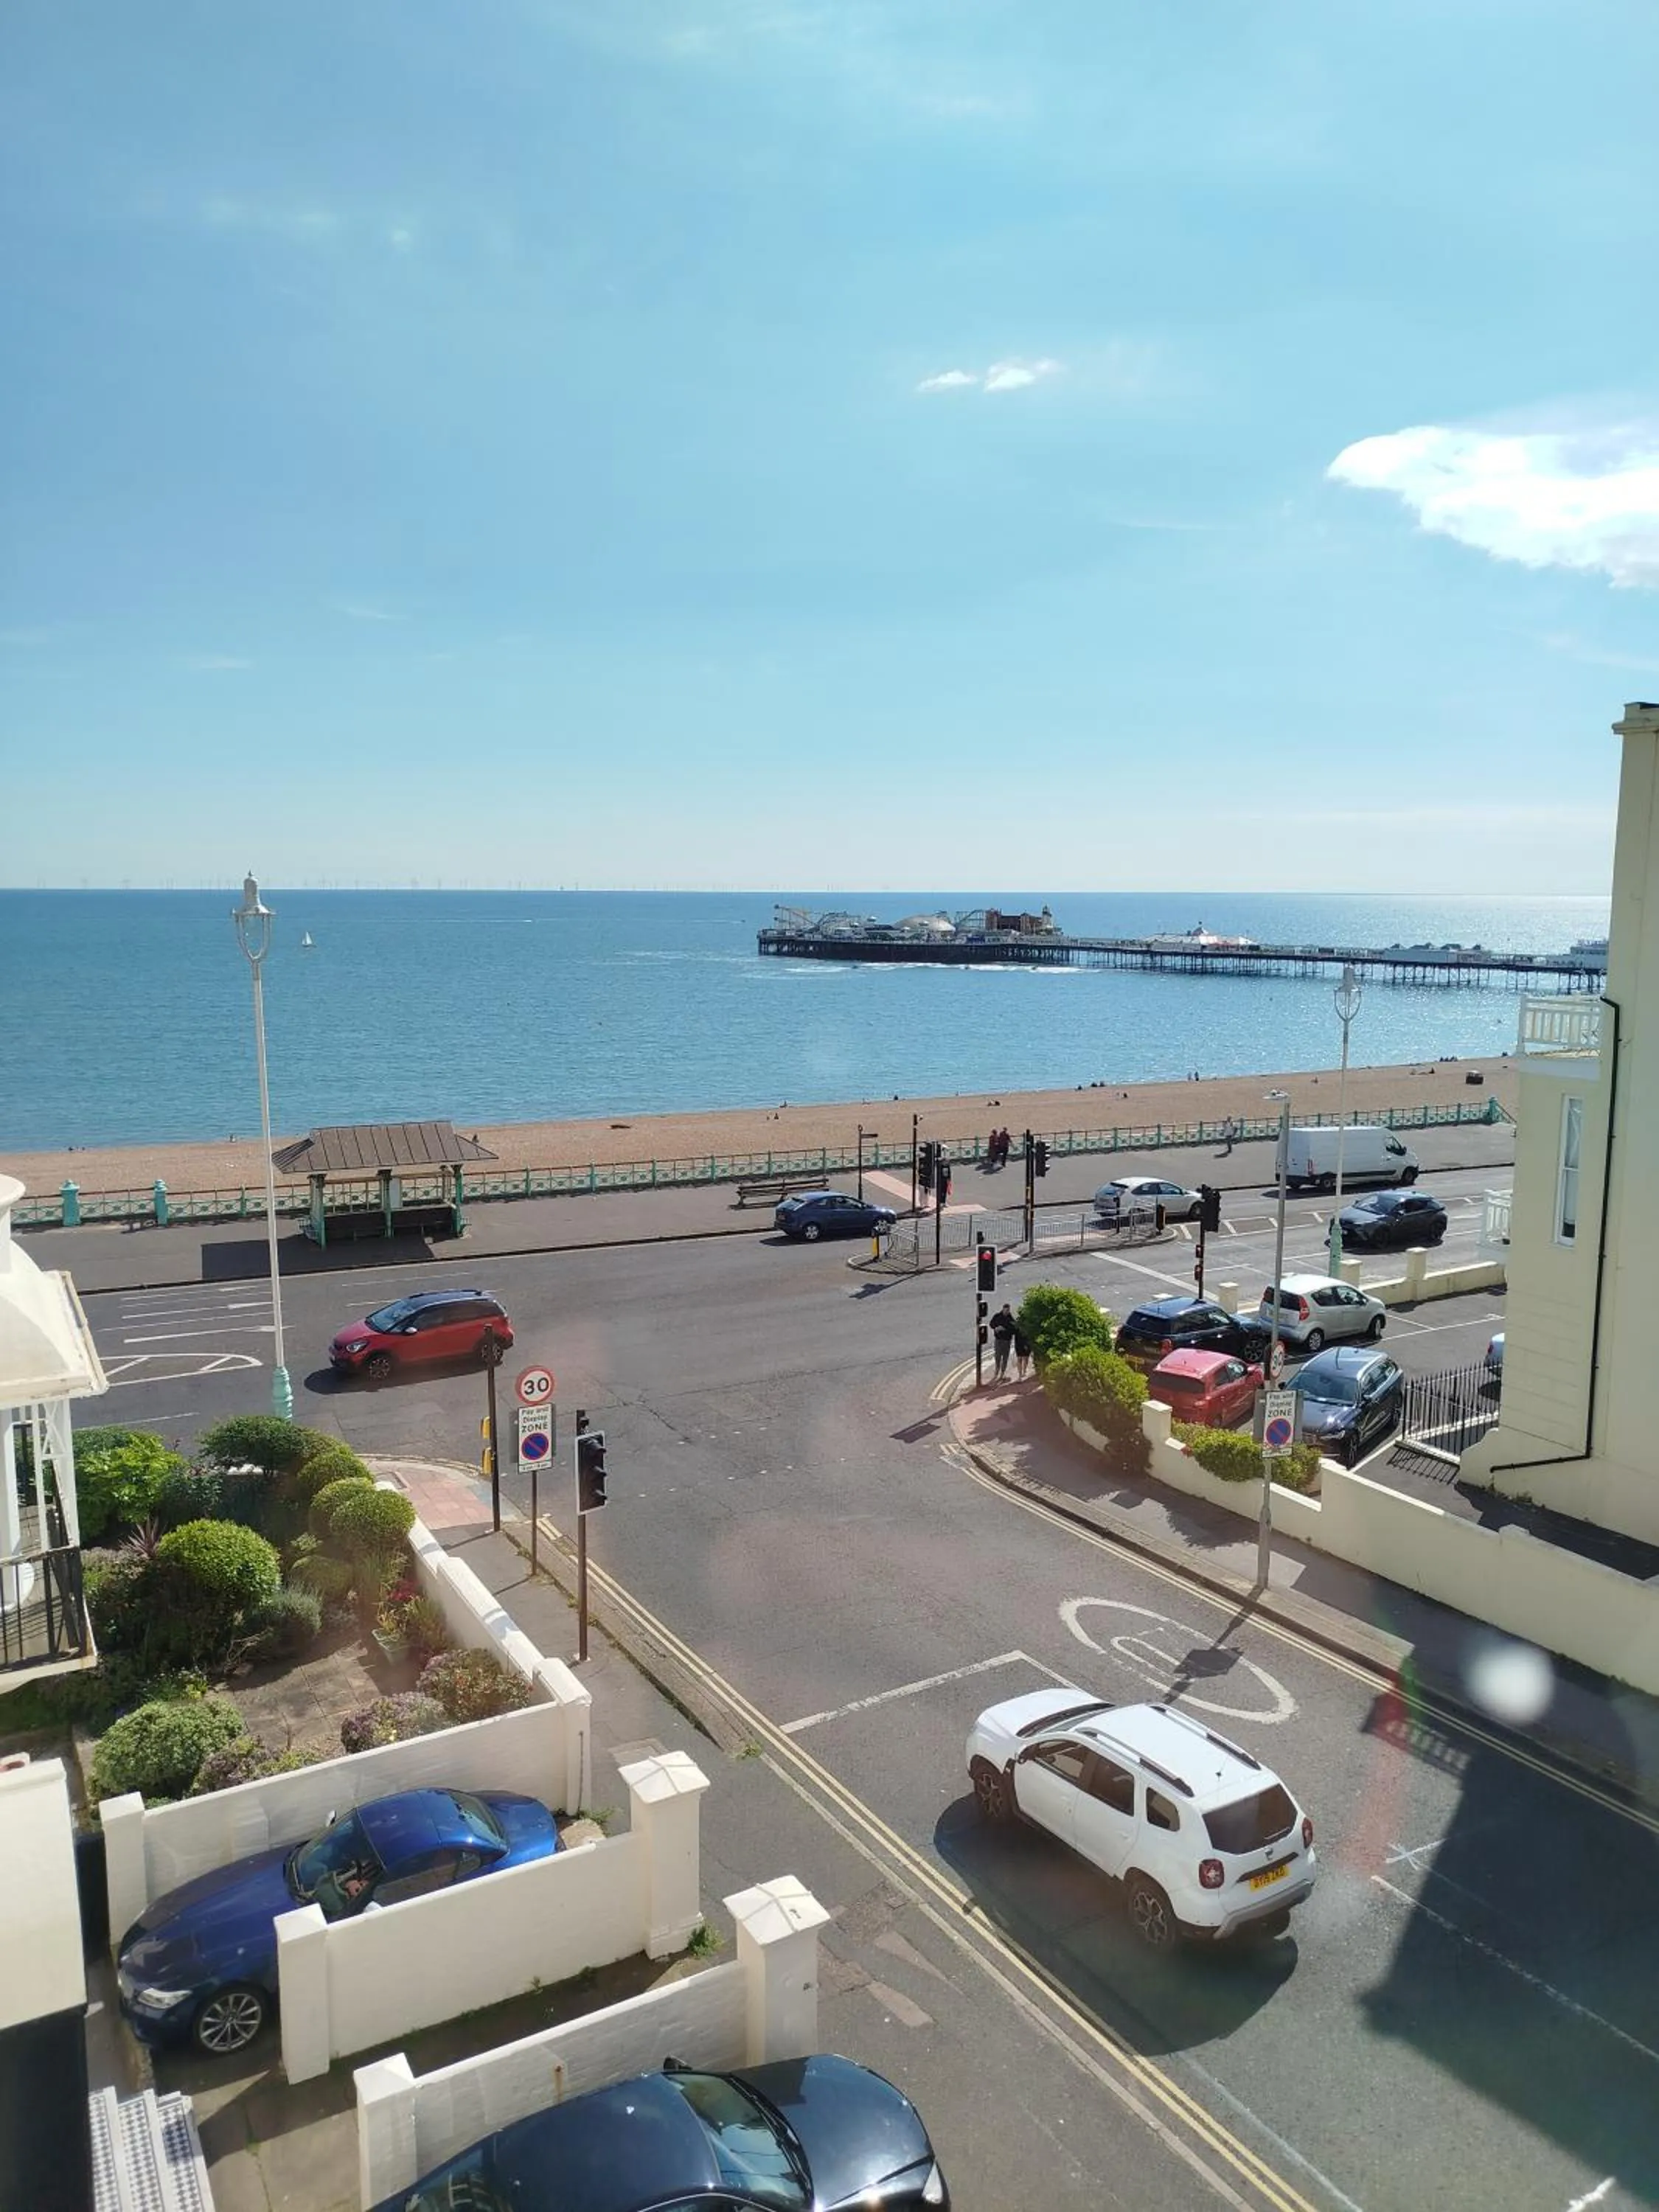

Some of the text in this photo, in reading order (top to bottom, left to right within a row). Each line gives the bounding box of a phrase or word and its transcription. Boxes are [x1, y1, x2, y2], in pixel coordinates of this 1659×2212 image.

[524, 1377, 549, 1394] 30
[1267, 1408, 1293, 1417] ZONE
[523, 1415, 547, 1423] Display
[521, 1422, 549, 1433] ZONE
